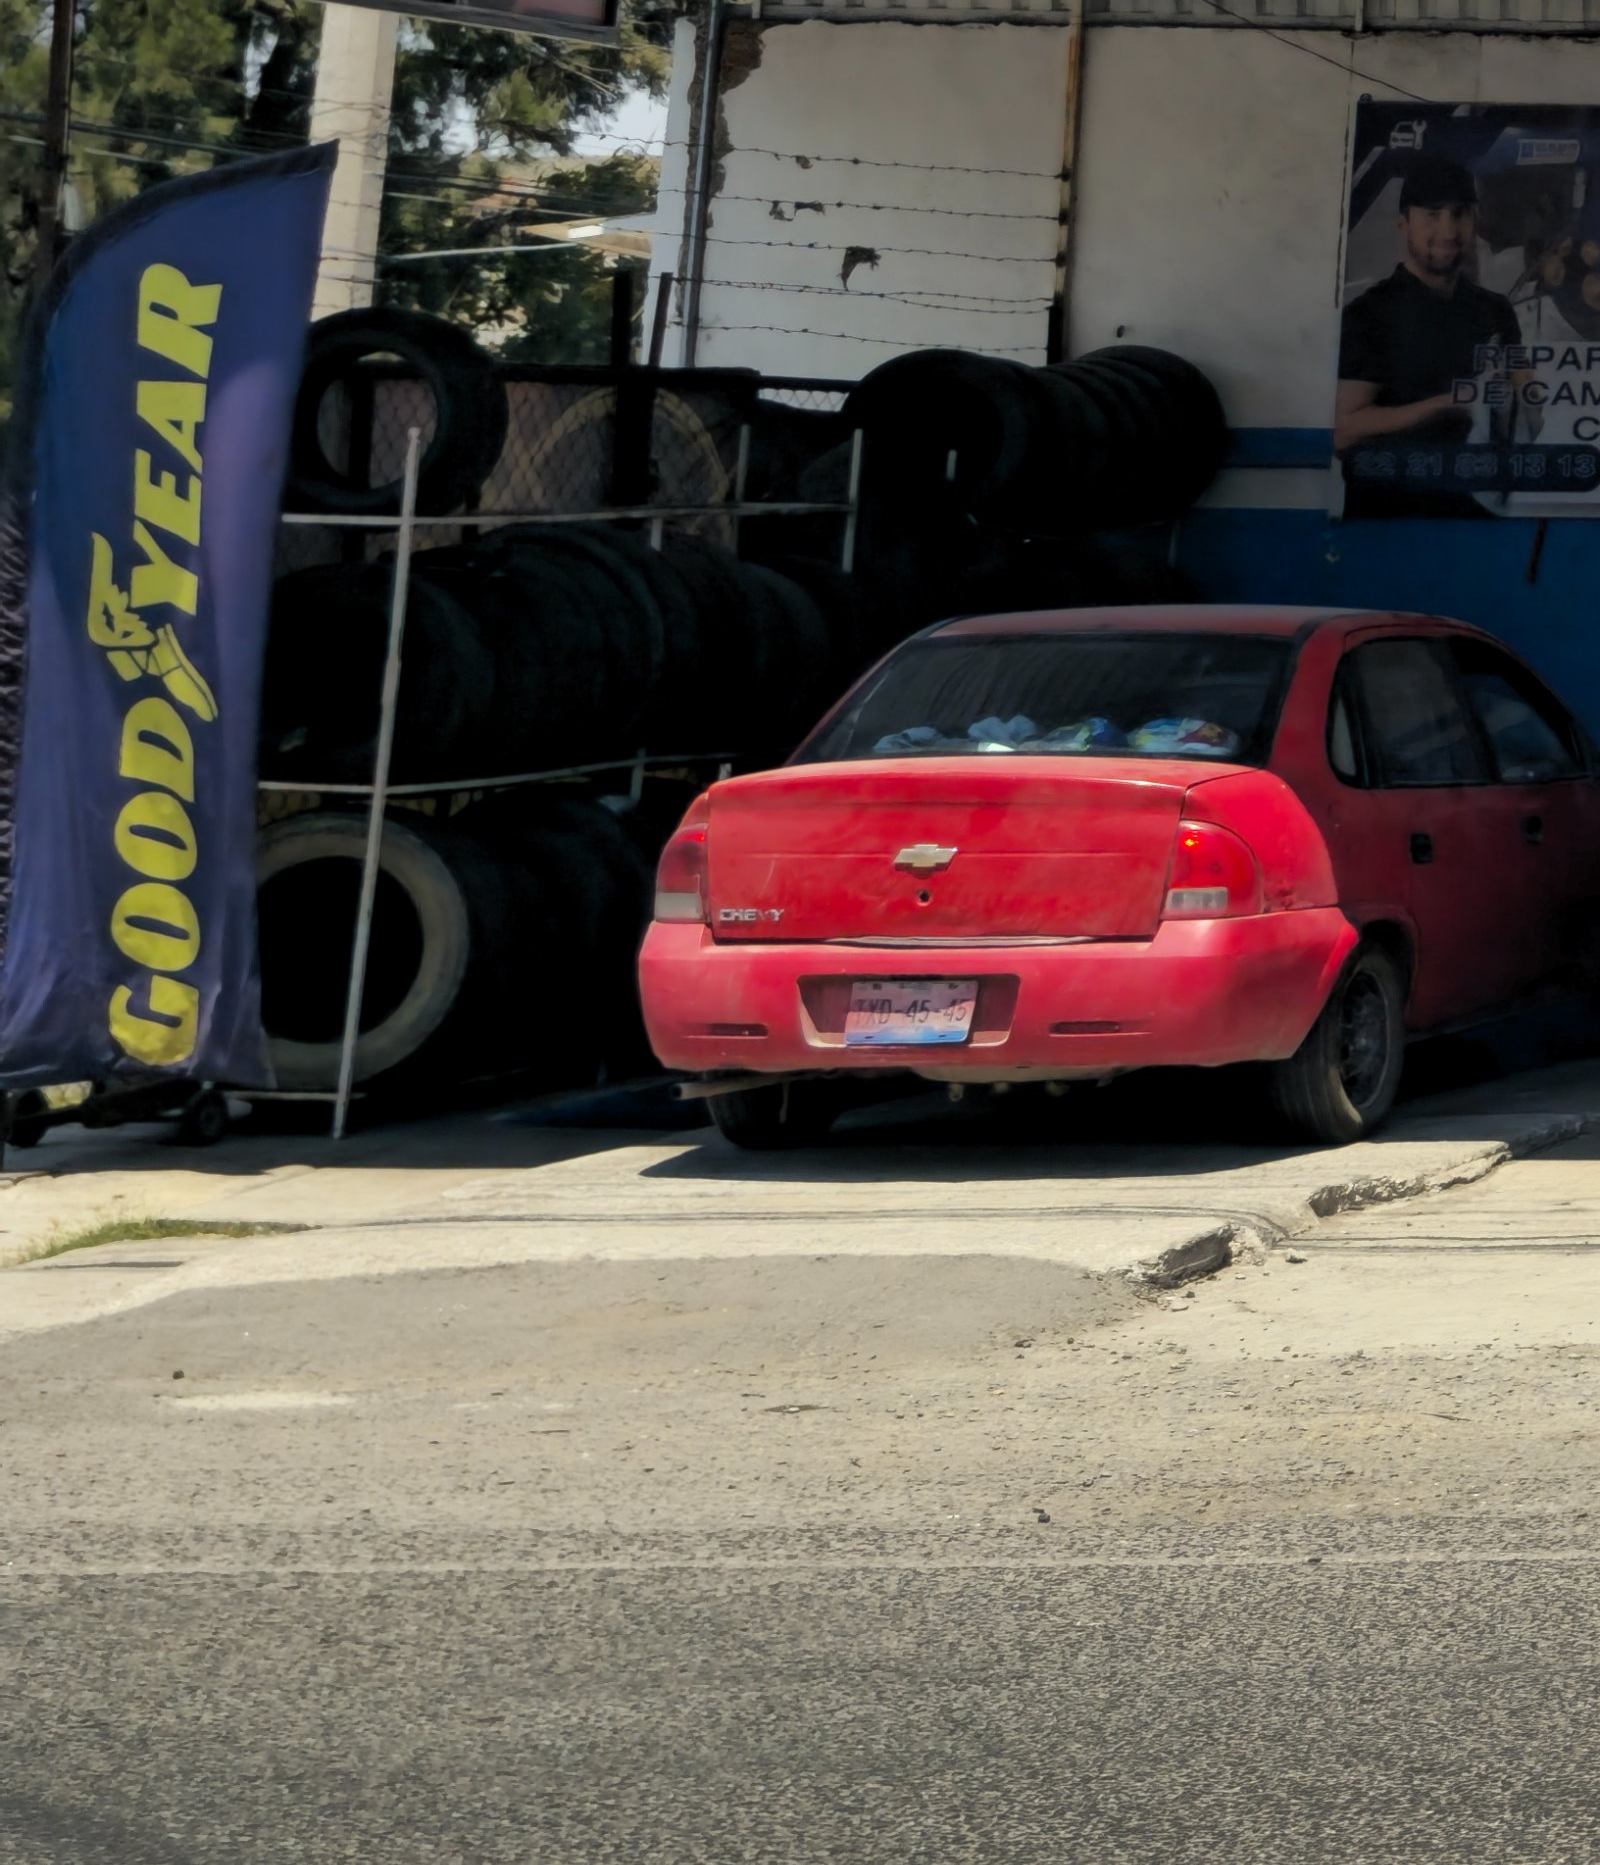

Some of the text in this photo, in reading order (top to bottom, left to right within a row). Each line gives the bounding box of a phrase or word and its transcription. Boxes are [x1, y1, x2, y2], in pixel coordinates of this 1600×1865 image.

[1452, 380, 1509, 406] DE
[1557, 453, 1596, 476] 13
[719, 908, 784, 921] CHEVY
